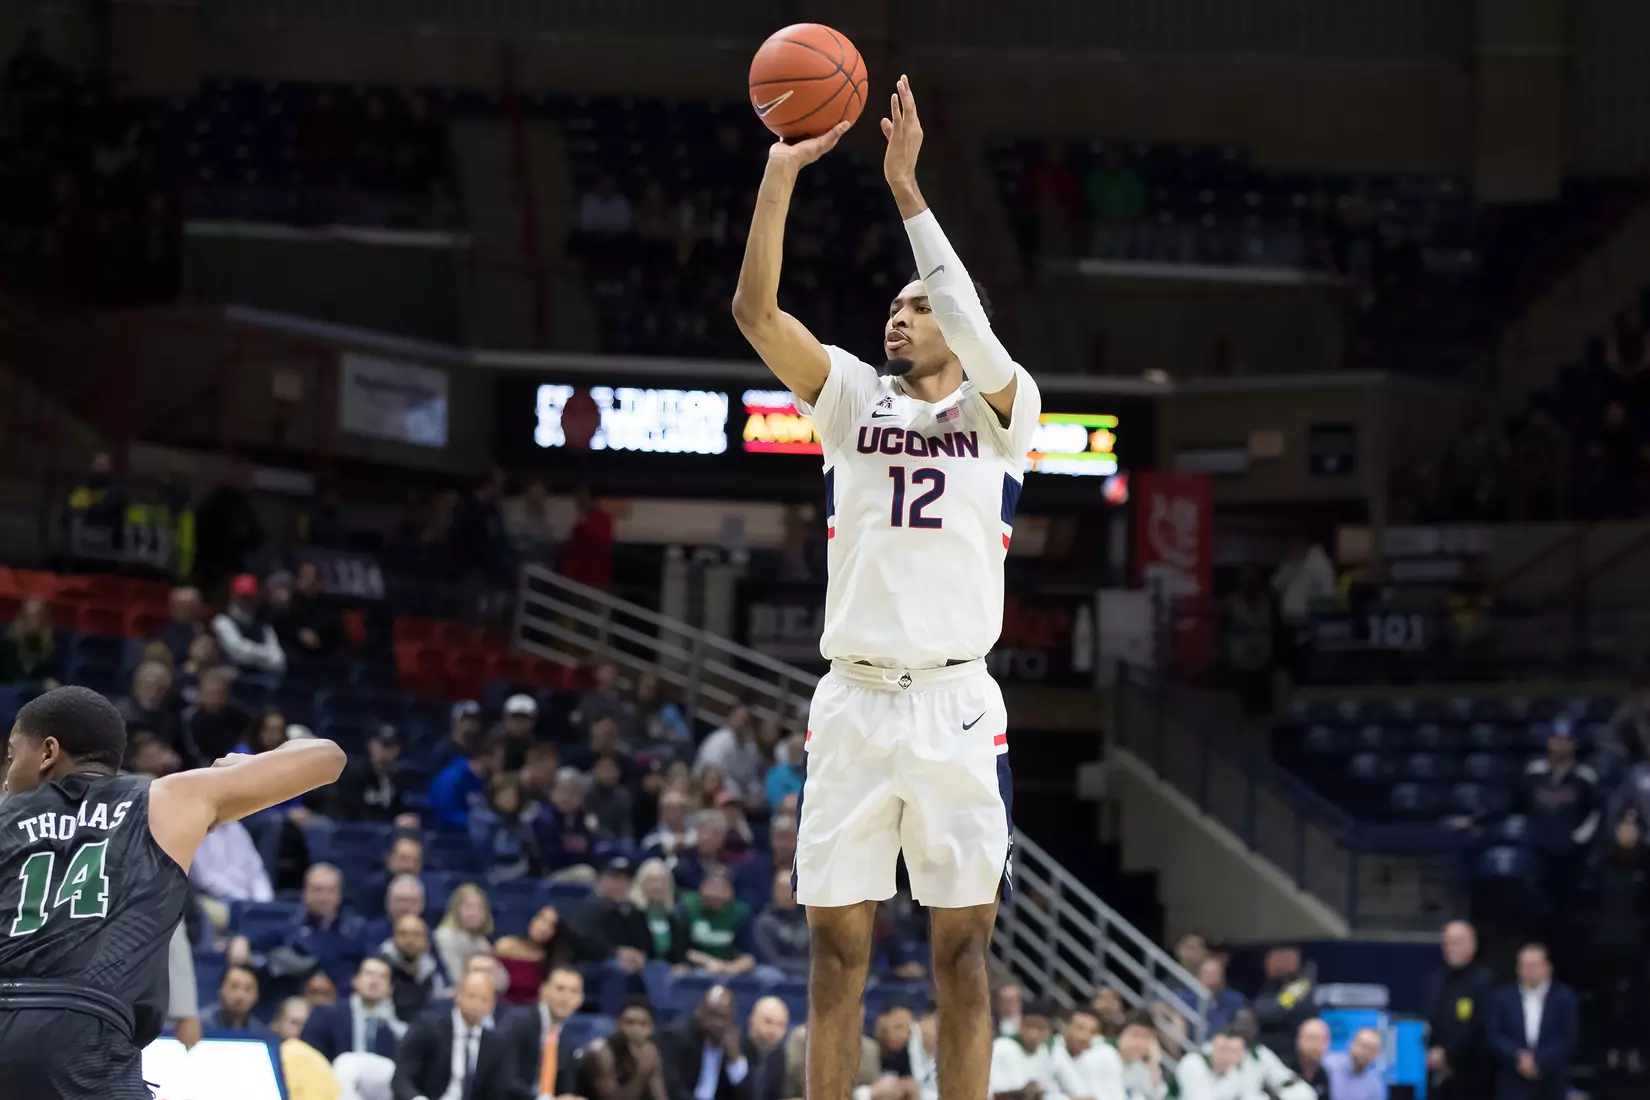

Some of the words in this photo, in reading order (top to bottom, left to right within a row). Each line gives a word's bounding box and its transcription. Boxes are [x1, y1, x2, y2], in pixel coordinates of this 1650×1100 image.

[857, 426, 979, 458] UCONN
[889, 466, 946, 529] 12
[10, 838, 110, 938] 14
